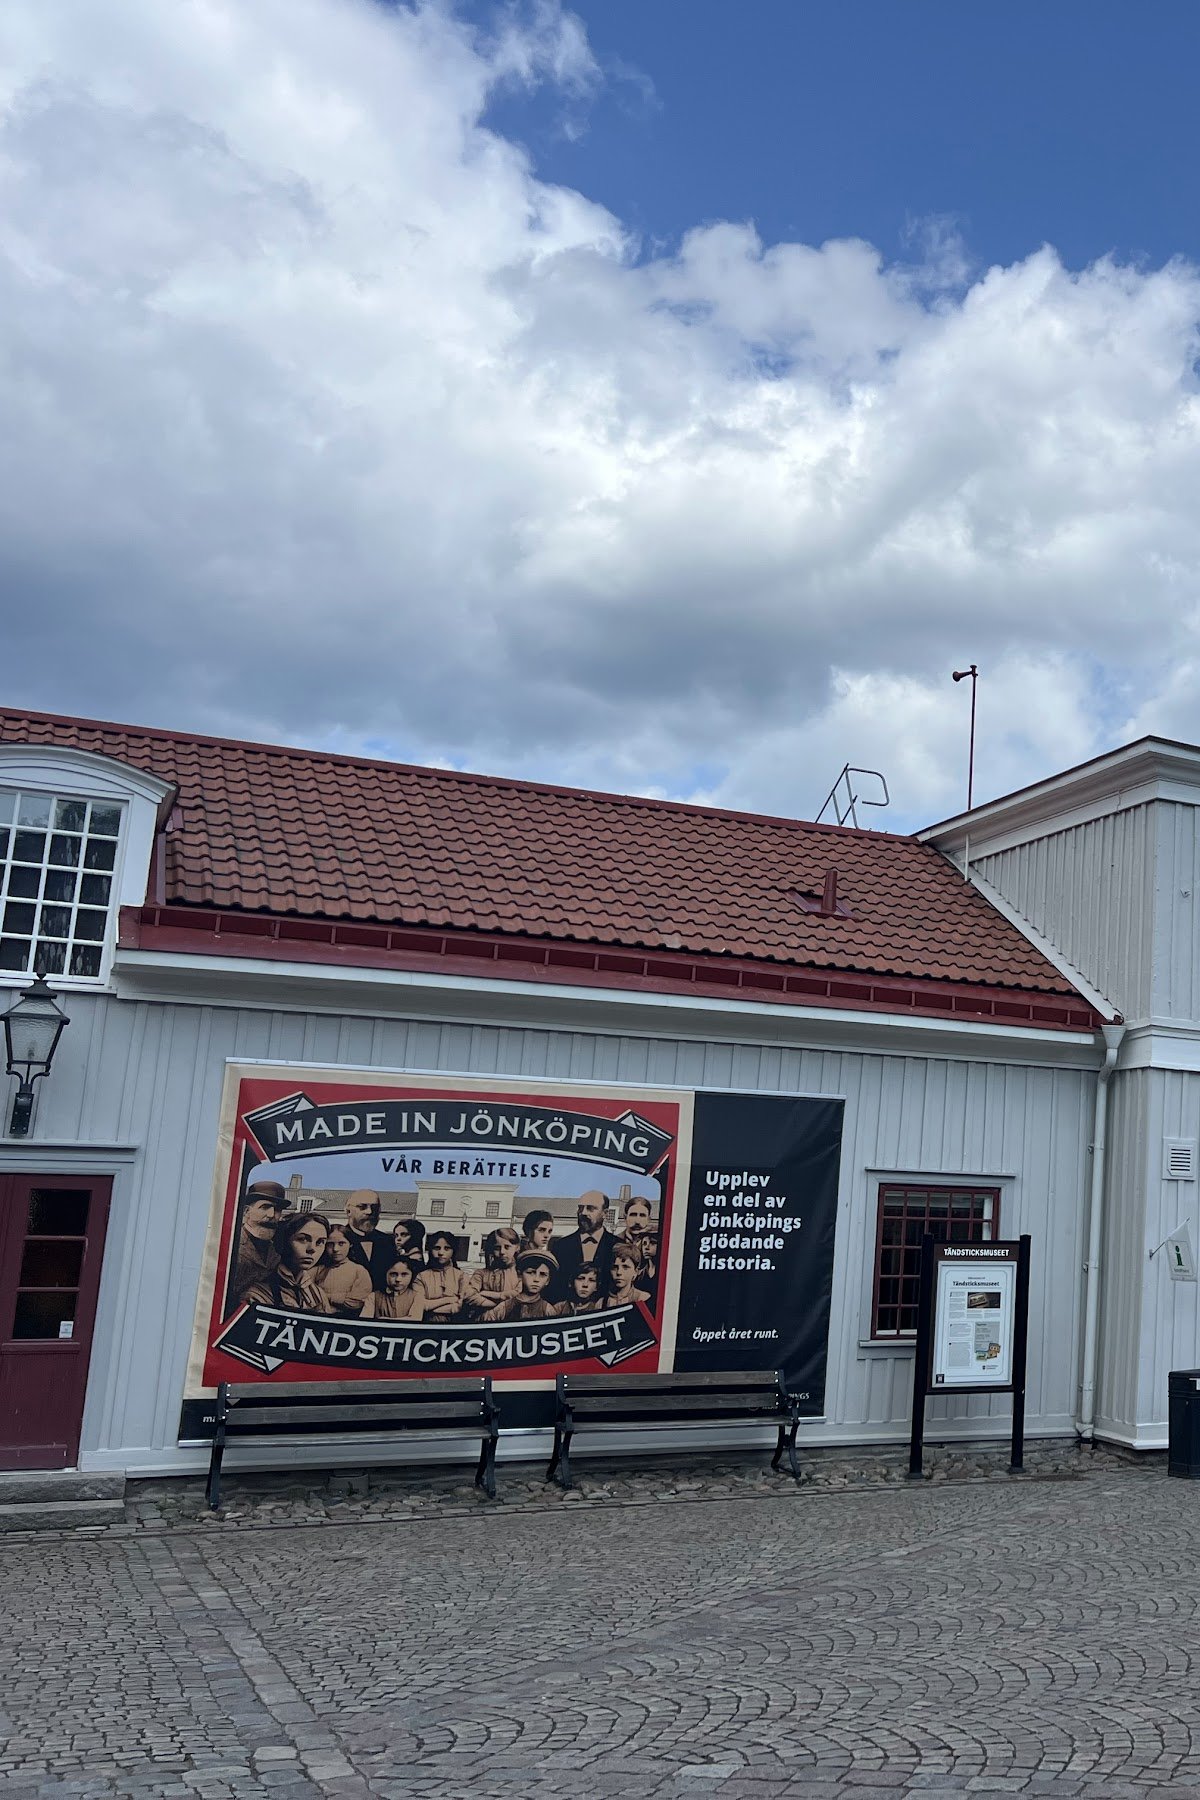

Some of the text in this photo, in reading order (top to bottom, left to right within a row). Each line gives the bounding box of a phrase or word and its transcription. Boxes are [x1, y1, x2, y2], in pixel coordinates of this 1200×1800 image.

[276, 1109, 650, 1157] MADE IN JÖNKÖPING
[381, 1154, 551, 1179] VÅR BERÄTTELSE
[705, 1170, 770, 1190] Upplev
[703, 1191, 786, 1208] en del av
[699, 1212, 802, 1233] Jönköpings
[699, 1233, 784, 1253] glödande
[943, 1247, 1010, 1257] TÄNDSTICKSMUSEET
[698, 1254, 776, 1270] historia.
[254, 1316, 627, 1364] TÄNDSTICKSMUSEET
[692, 1327, 779, 1342] Öppet året runt.
